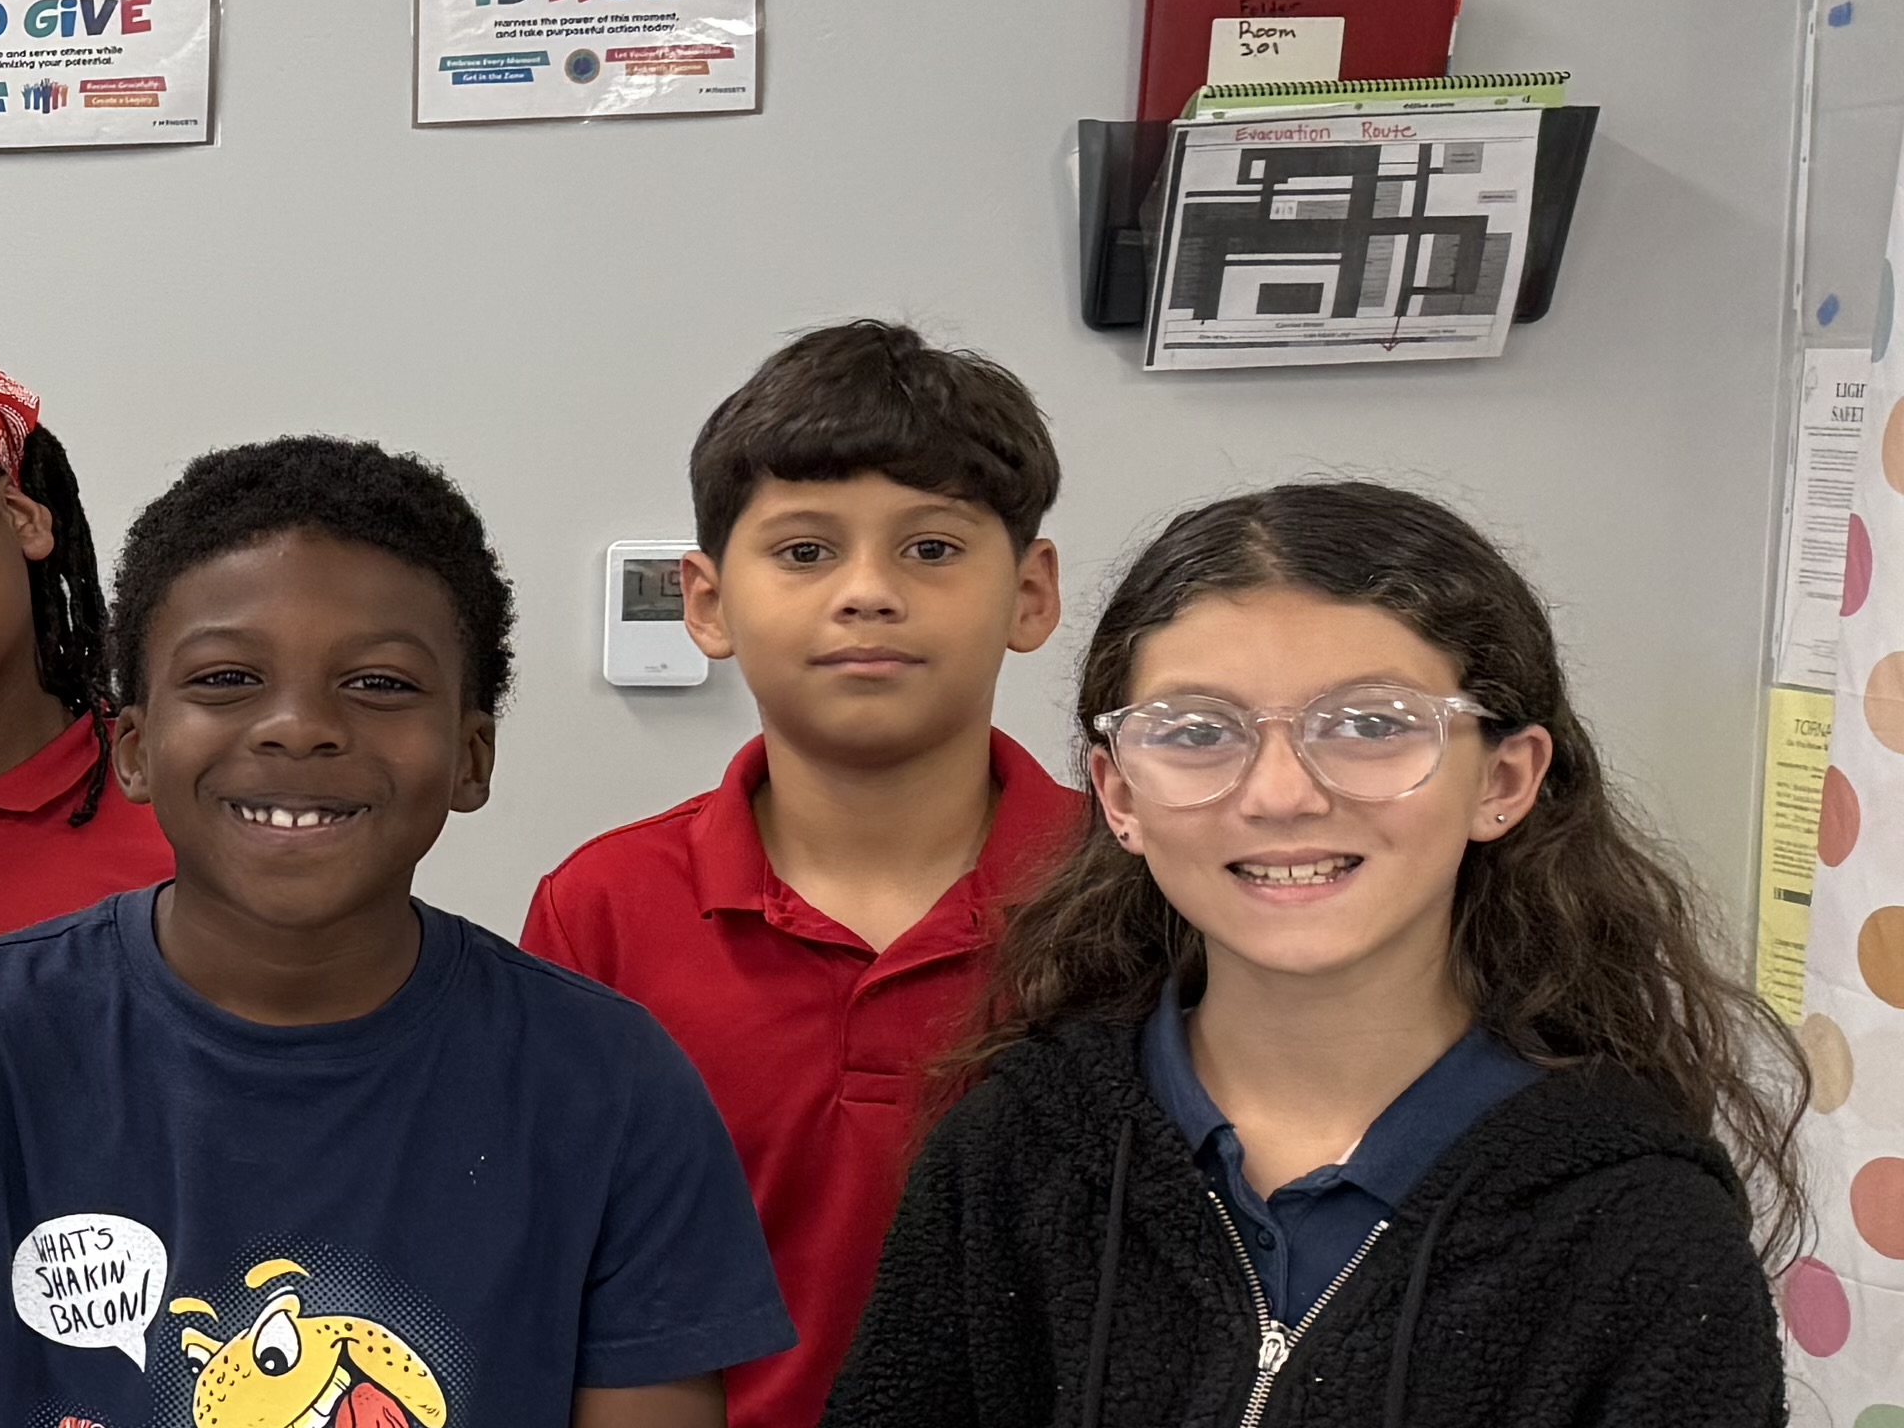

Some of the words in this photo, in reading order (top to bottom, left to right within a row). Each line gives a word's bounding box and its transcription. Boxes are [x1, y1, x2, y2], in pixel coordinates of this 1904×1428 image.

[1238, 20, 1297, 40] Room
[1234, 124, 1332, 142] Evacuation
[1361, 121, 1418, 140] Route
[32, 1225, 114, 1264] WHAT'S
[35, 1250, 132, 1300] SHAKIN'
[50, 1269, 150, 1336] BACON!
